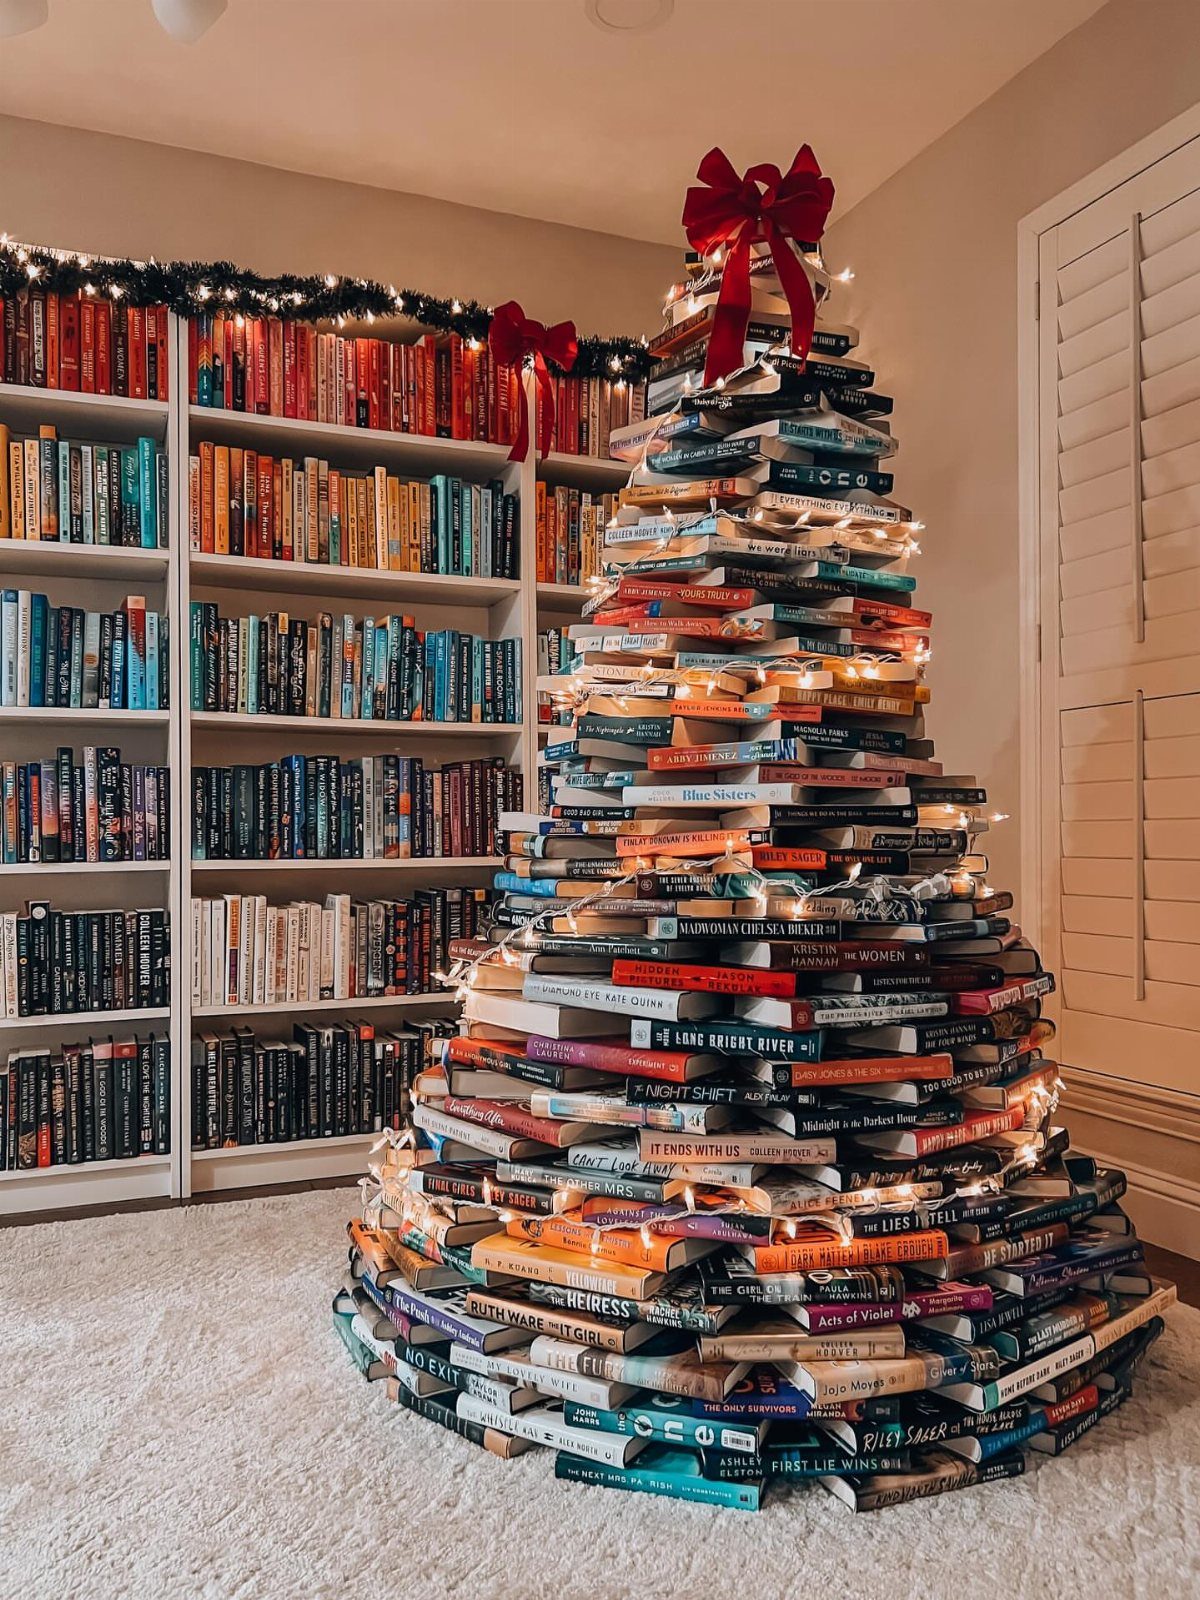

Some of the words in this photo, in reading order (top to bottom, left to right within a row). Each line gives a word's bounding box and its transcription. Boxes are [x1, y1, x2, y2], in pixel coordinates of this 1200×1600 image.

[662, 454, 682, 463] WOMAN
[690, 451, 706, 459] CABIN
[780, 496, 831, 511] EVERYTHING
[608, 529, 632, 540] COLLEEN
[634, 527, 657, 537] HOOVER
[641, 588, 671, 597] JIMENEZ
[680, 589, 706, 599] YOURS
[707, 590, 730, 599] TRULY
[667, 754, 691, 764] ABBY
[694, 752, 737, 762] JIMENEZ
[683, 789, 710, 801] Blue
[713, 788, 756, 801] Sisters
[623, 837, 647, 847] FINLAY
[692, 833, 725, 842] KILLING
[140, 915, 150, 950] COLLEEN
[680, 923, 739, 935] MADWOMAN
[741, 923, 784, 935] CHELSEA
[788, 923, 824, 935] BIEKER
[793, 945, 836, 954] KRISTIN
[859, 950, 905, 962] WOMEN
[140, 953, 150, 985] HOOVER
[791, 957, 838, 967] HANNAH
[542, 985, 581, 997] DIAMOND
[585, 989, 600, 999] EYE
[606, 993, 627, 1004] KATE
[631, 996, 663, 1009] QUINN
[533, 1041, 574, 1052] CHRISTINA
[709, 1035, 753, 1050] BRIGHT
[758, 1037, 794, 1053] RIVER
[208, 1051, 216, 1073] HELLO
[536, 1050, 570, 1060] LAUREN
[628, 1058, 665, 1070] EXPERIMENT
[645, 1084, 691, 1098] NIGHT
[692, 1087, 736, 1102] SHIFT
[744, 1092, 763, 1101] ALEX
[802, 1119, 840, 1132] Midnight
[863, 1115, 894, 1127] Darkest
[651, 1143, 660, 1155] IT
[664, 1144, 692, 1156] ENDS
[694, 1144, 723, 1156] WITH
[726, 1145, 740, 1157] US
[750, 1148, 781, 1156] COLLEEN
[428, 1178, 449, 1192] FINAL
[452, 1180, 476, 1197] GIRLS
[508, 1193, 536, 1208] SAGER
[864, 1224, 878, 1233] THE
[882, 1216, 910, 1232] LIES
[984, 1250, 996, 1267] HE
[566, 1271, 617, 1295] YELLOWFACE
[711, 1286, 732, 1295] THE
[737, 1285, 763, 1295] GIRL
[767, 1285, 781, 1294] ON
[819, 1285, 849, 1293] PAULA
[395, 1294, 410, 1313] The
[410, 1303, 430, 1325] Push
[567, 1291, 630, 1318] HEIRESS
[650, 1304, 680, 1318] RACHEL
[471, 1301, 505, 1321] RUTH
[508, 1310, 544, 1330] WARE
[647, 1315, 682, 1328] HAWKINS
[818, 1316, 842, 1328] Acts
[847, 1313, 857, 1323] of
[861, 1308, 894, 1322] Violet
[560, 1324, 570, 1335] IT
[574, 1328, 603, 1346] GIRL
[816, 1349, 858, 1357] HOOVER
[405, 1346, 424, 1367] NO
[429, 1359, 461, 1386] EXIT
[930, 1366, 957, 1378] Giver
[970, 1361, 994, 1373] Stars
[575, 1408, 597, 1418] JOHN
[704, 1404, 720, 1412] THE
[723, 1405, 745, 1413] ONLY
[748, 1405, 796, 1414] SURVIVORS
[572, 1415, 600, 1426] MARRS
[863, 1431, 900, 1452] RILEY
[905, 1422, 948, 1445] SAGER
[720, 1457, 763, 1466] ASHLEY
[772, 1461, 808, 1473] FIRST
[815, 1460, 836, 1471] LIE
[841, 1459, 878, 1470] WINS
